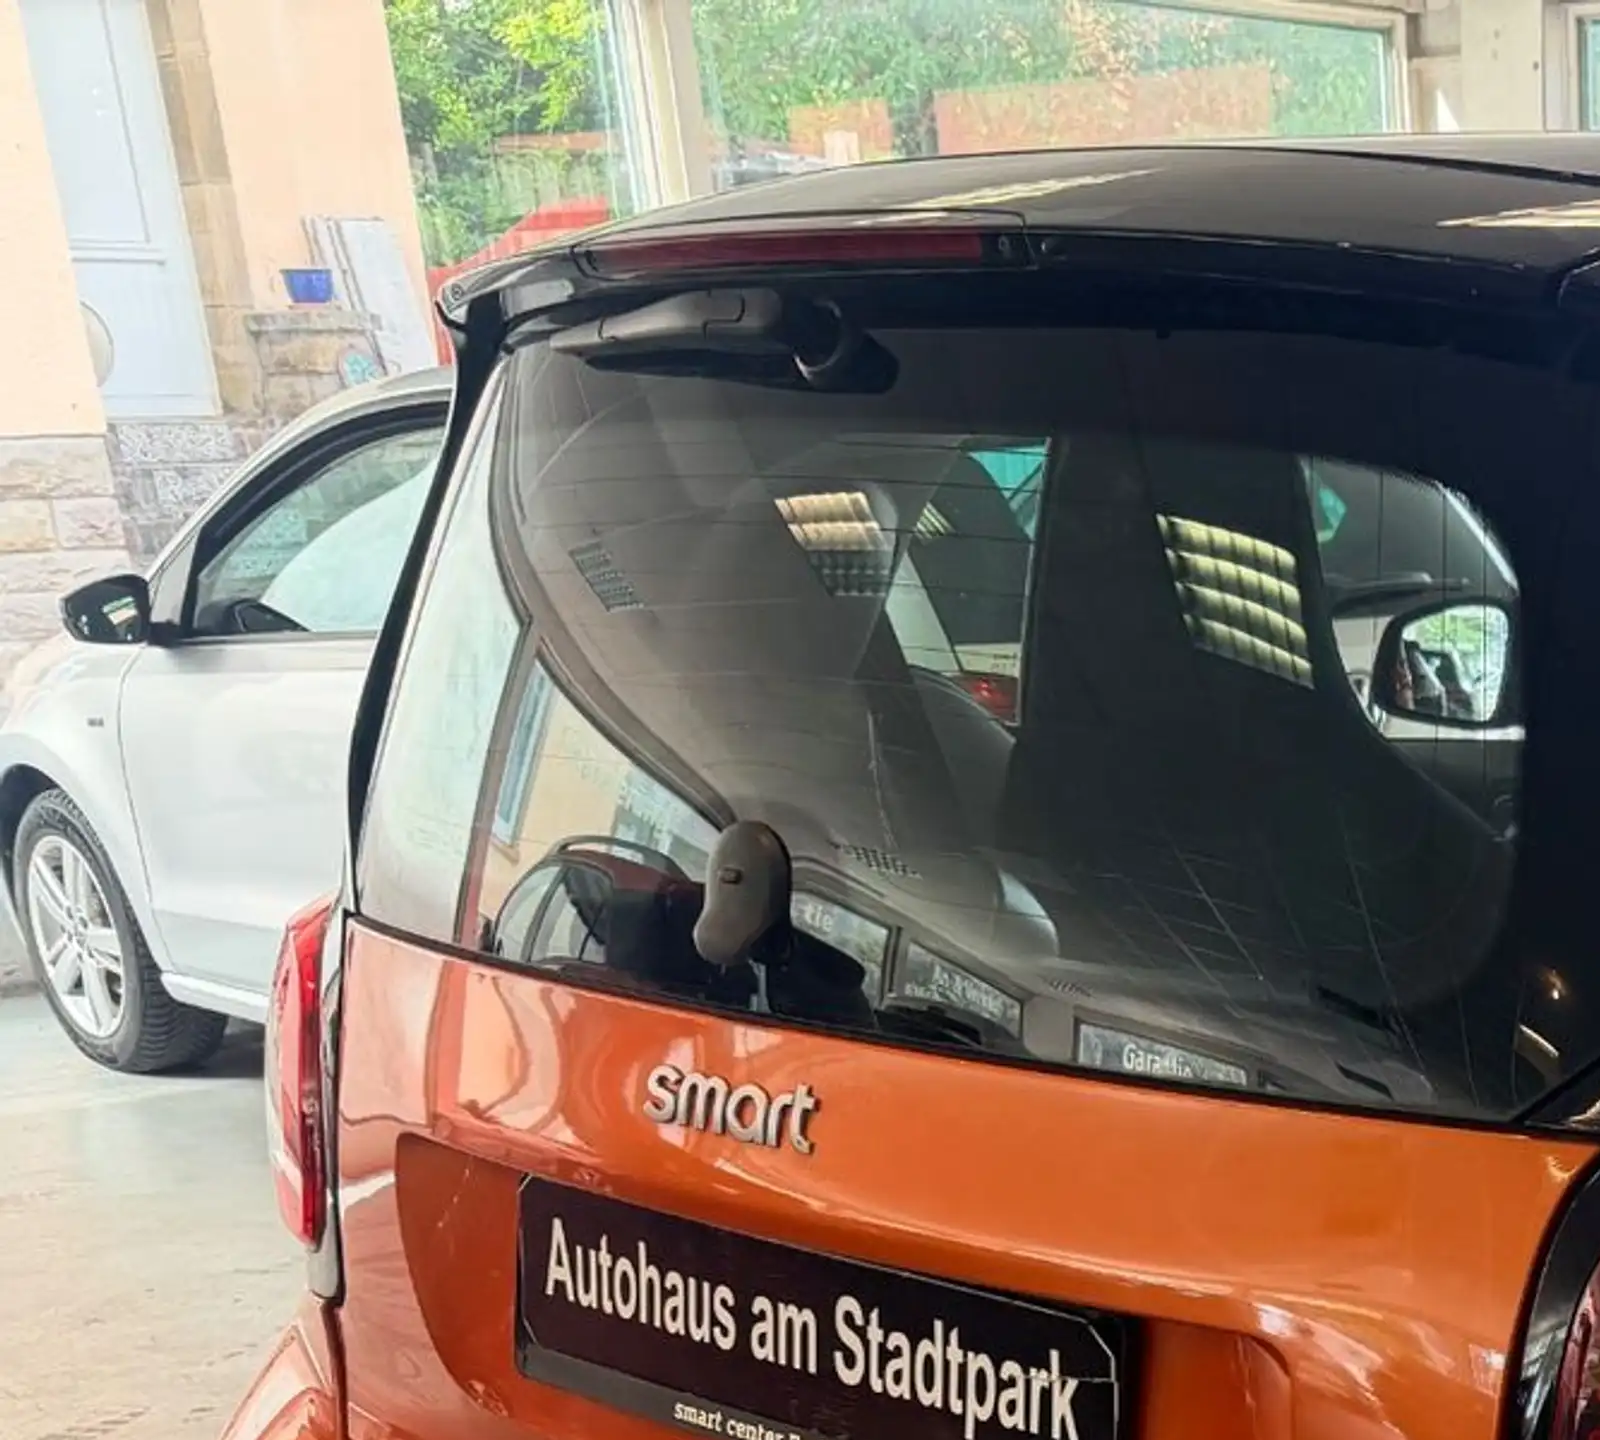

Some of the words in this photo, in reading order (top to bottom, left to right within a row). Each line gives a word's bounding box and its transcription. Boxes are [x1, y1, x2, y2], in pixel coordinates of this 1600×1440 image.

[643, 1064, 816, 1154] smart
[545, 1216, 736, 1350] Autohaus
[750, 1295, 818, 1375] am
[674, 1401, 723, 1434] smart
